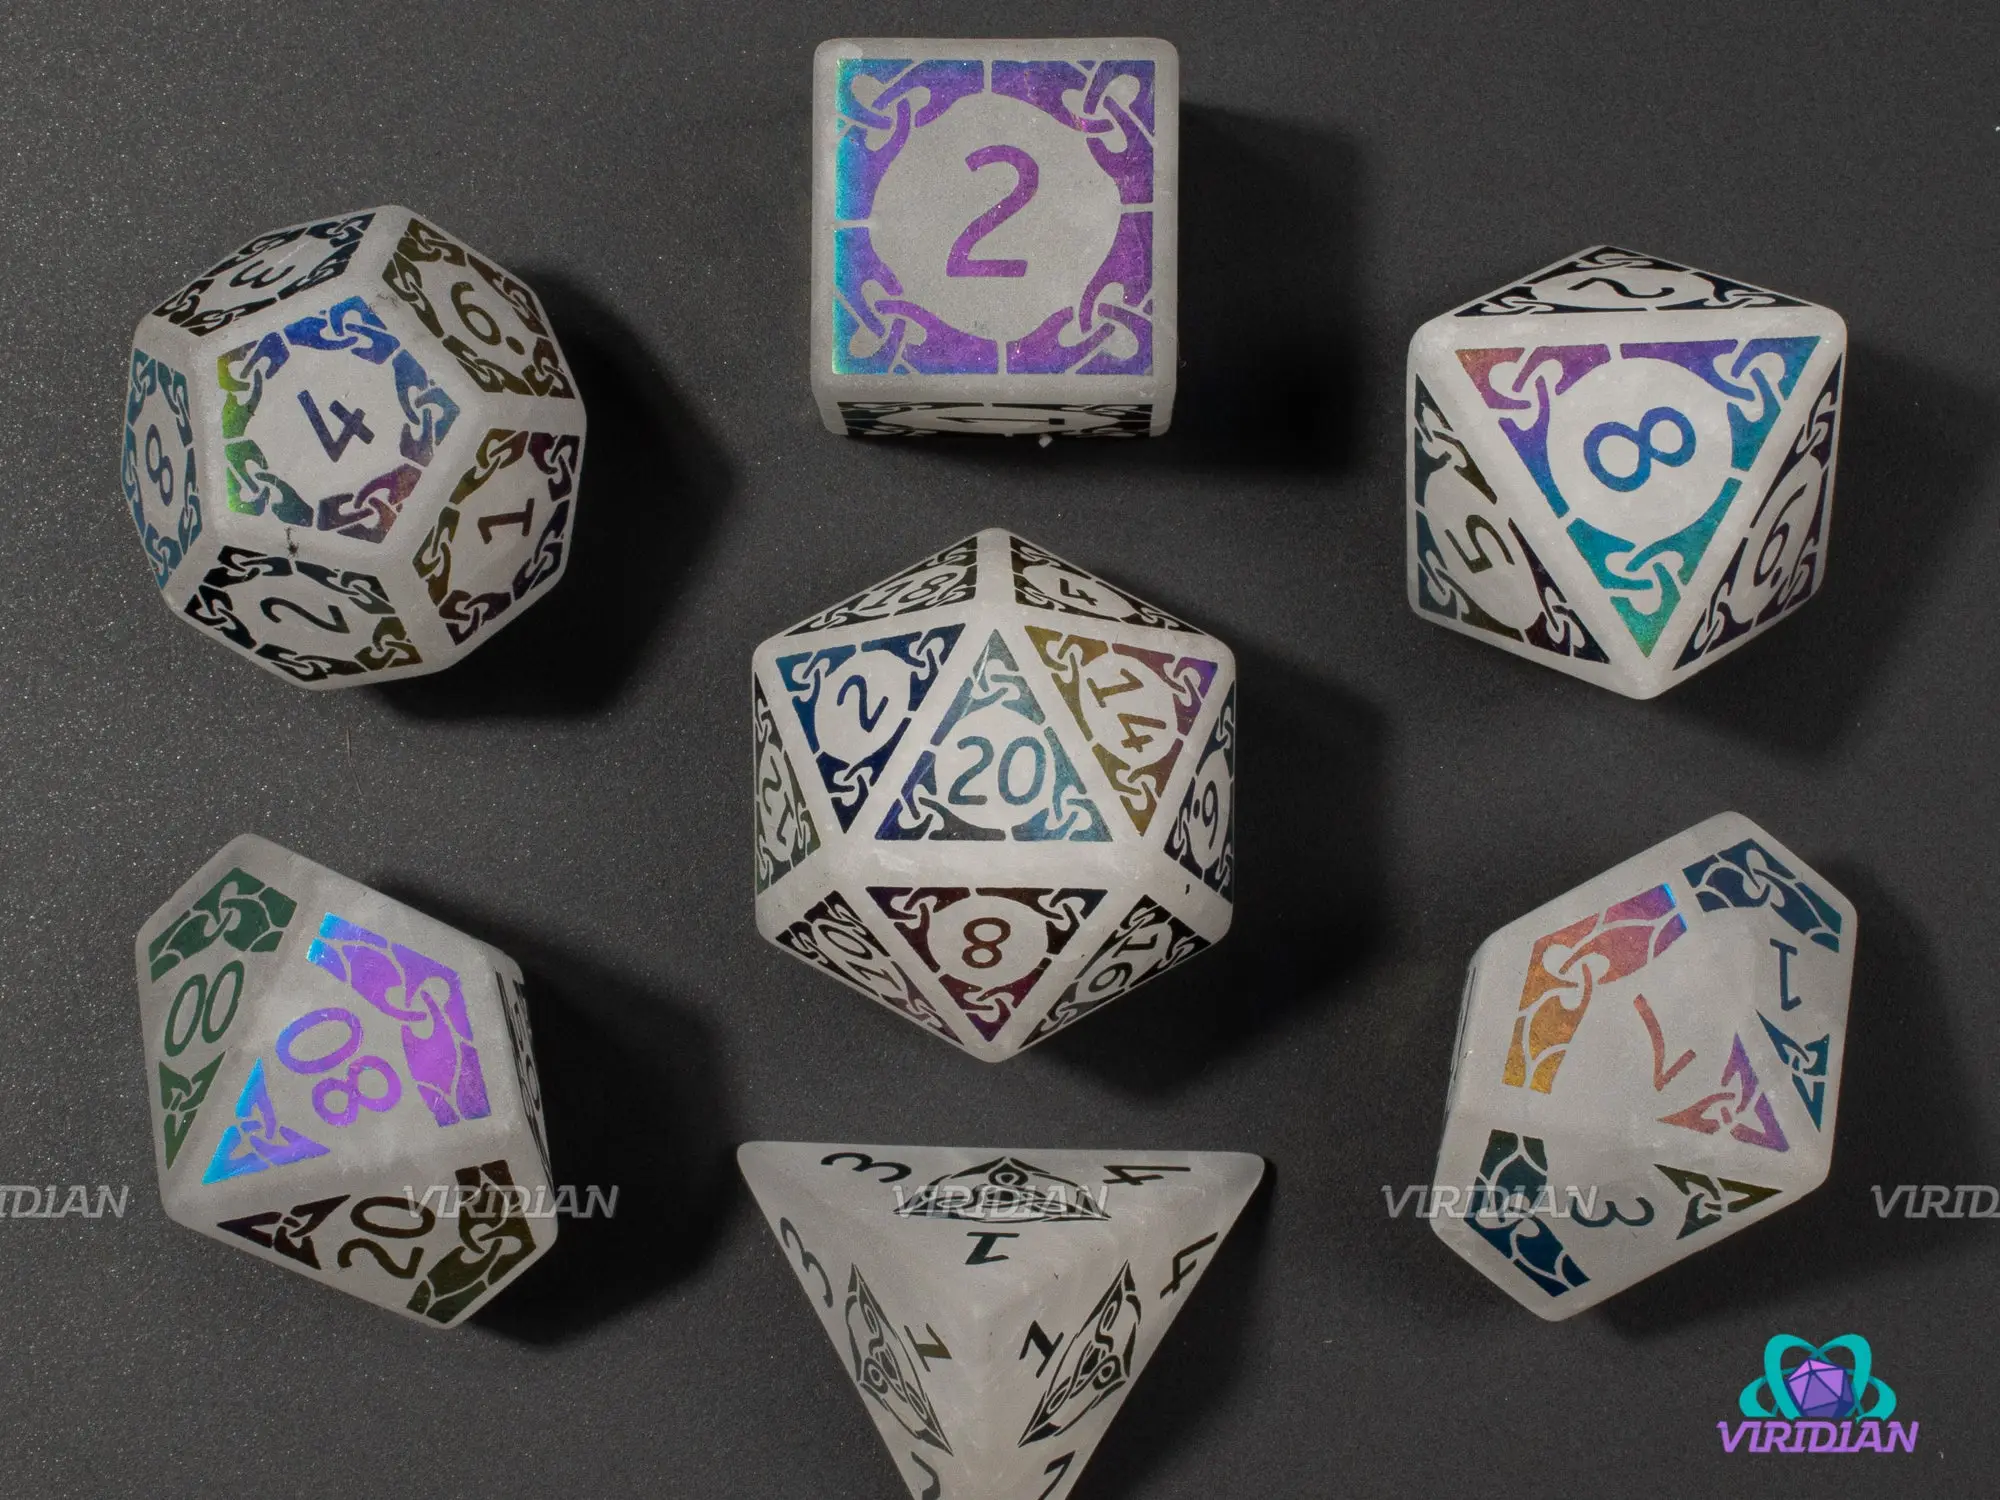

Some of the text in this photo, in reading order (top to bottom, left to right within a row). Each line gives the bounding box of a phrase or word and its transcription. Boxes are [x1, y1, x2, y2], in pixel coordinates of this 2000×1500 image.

[946, 144, 1039, 277] 2
[230, 261, 294, 288] 3
[297, 390, 375, 462] 4
[1583, 405, 1697, 493] 8
[144, 424, 174, 506] 8
[478, 497, 535, 544] 1
[1444, 515, 1516, 574] 5
[260, 597, 350, 634] 2
[859, 572, 957, 611] 18
[1060, 578, 1098, 606] 4
[837, 674, 889, 732] 2
[1088, 668, 1168, 753] 14
[947, 736, 1046, 806] 20
[961, 917, 1011, 969] 8
[1769, 937, 1802, 1012] 1
[163, 960, 245, 1057] 00
[275, 1007, 403, 1127] 80
[1633, 993, 1697, 1091] 7
[820, 1152, 913, 1184] 3
[1103, 1163, 1191, 1186] 4
[337, 1196, 436, 1280] 20
[1571, 1196, 1655, 1228] 3
[780, 1216, 834, 1308] 3
[965, 1231, 1020, 1266] 1
[1159, 1231, 1219, 1299] 4
[904, 1322, 953, 1372] 1
[1019, 1319, 1065, 1379] 1
